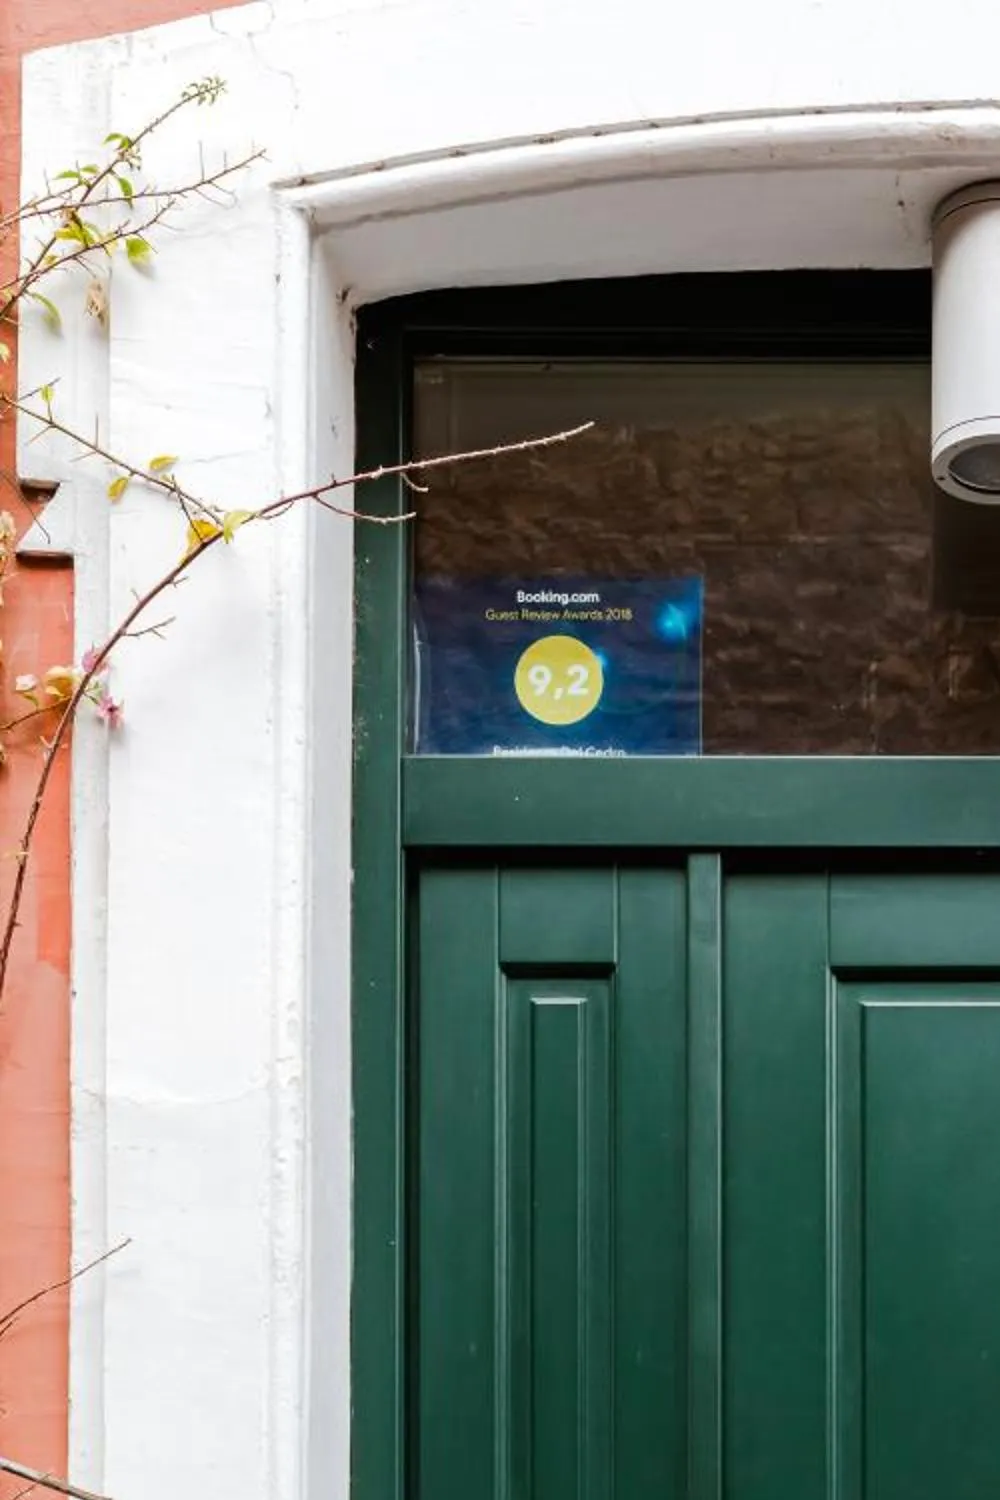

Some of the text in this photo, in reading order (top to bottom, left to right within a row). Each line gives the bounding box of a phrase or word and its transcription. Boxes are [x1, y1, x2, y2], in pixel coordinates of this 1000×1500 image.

[517, 589, 600, 605] Booking.com
[485, 608, 633, 620] Guest Review Awards 2018
[528, 664, 589, 699] 9,2
